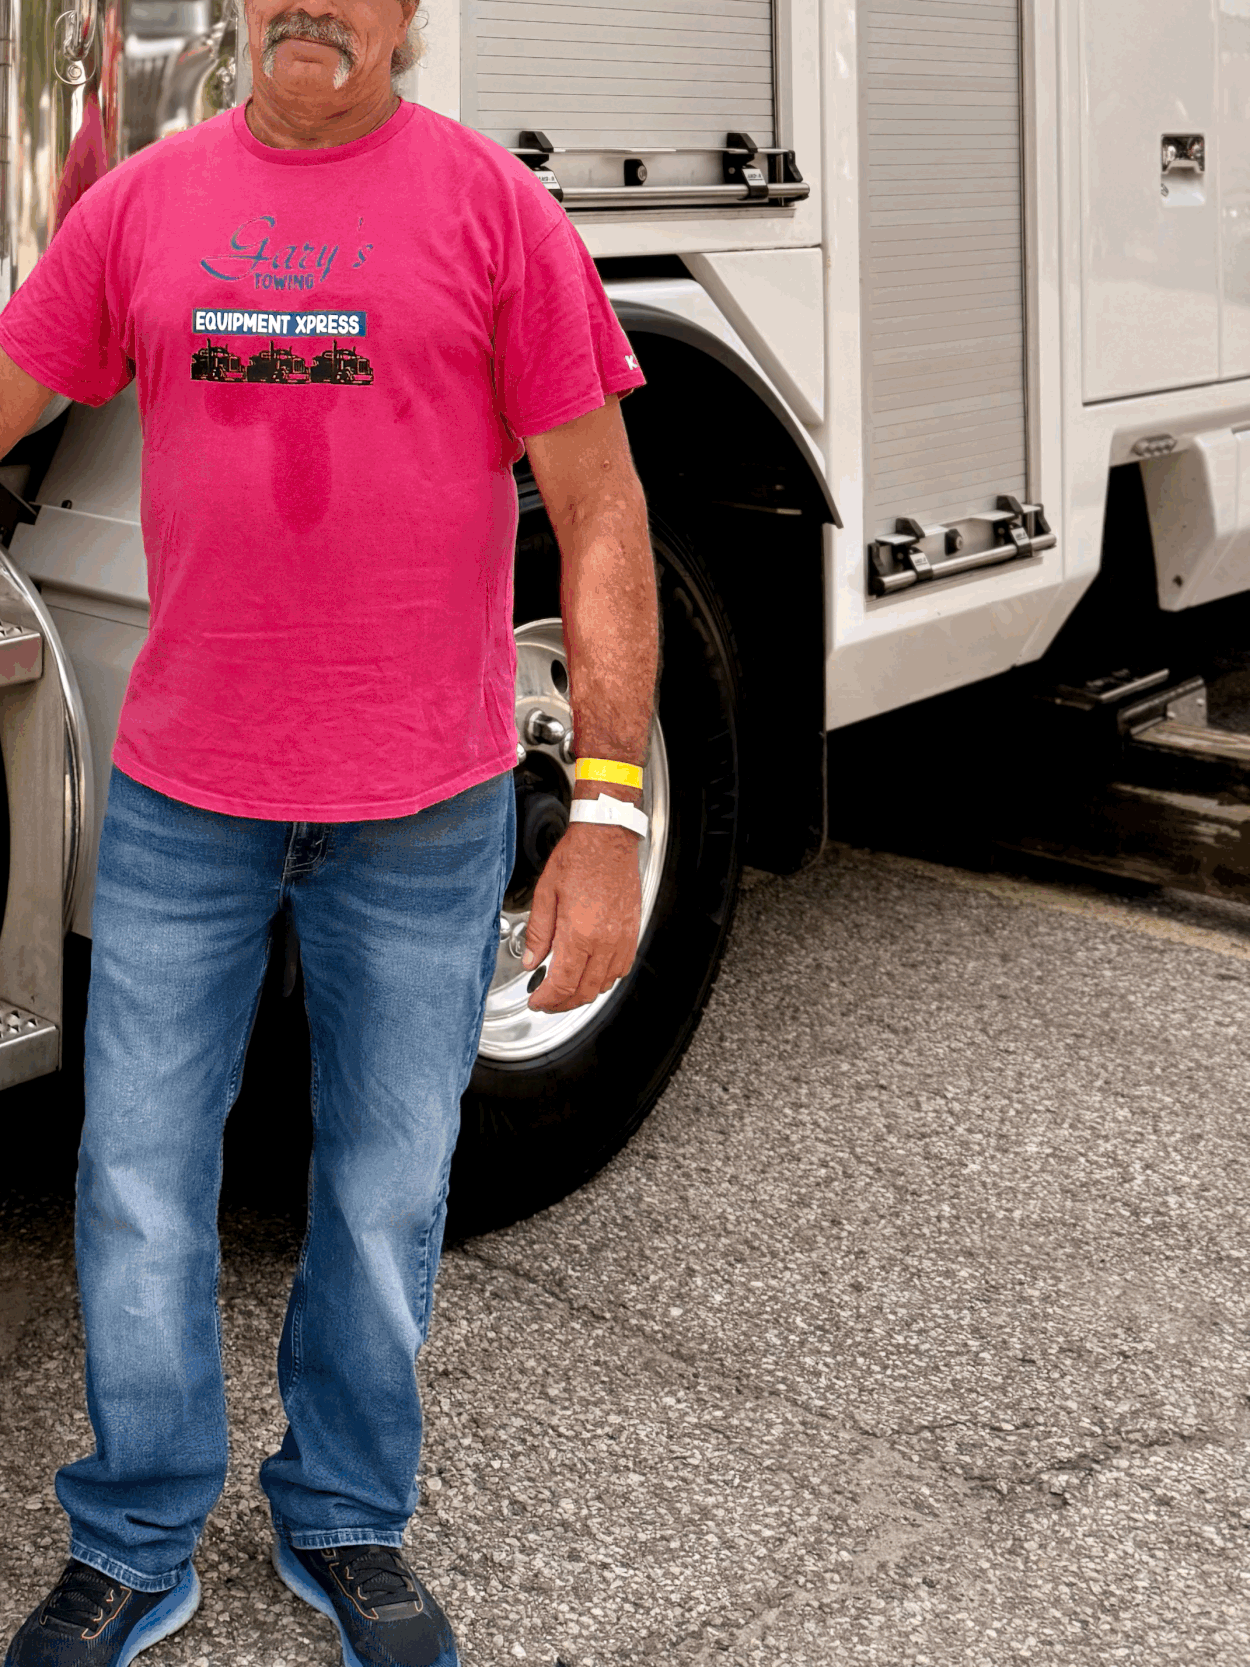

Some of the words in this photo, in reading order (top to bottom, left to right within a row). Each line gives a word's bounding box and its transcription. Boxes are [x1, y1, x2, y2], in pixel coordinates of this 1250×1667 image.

[253, 272, 315, 291] TOWING
[195, 311, 291, 334] EQUIPMENT
[294, 314, 360, 335] XPRESS
